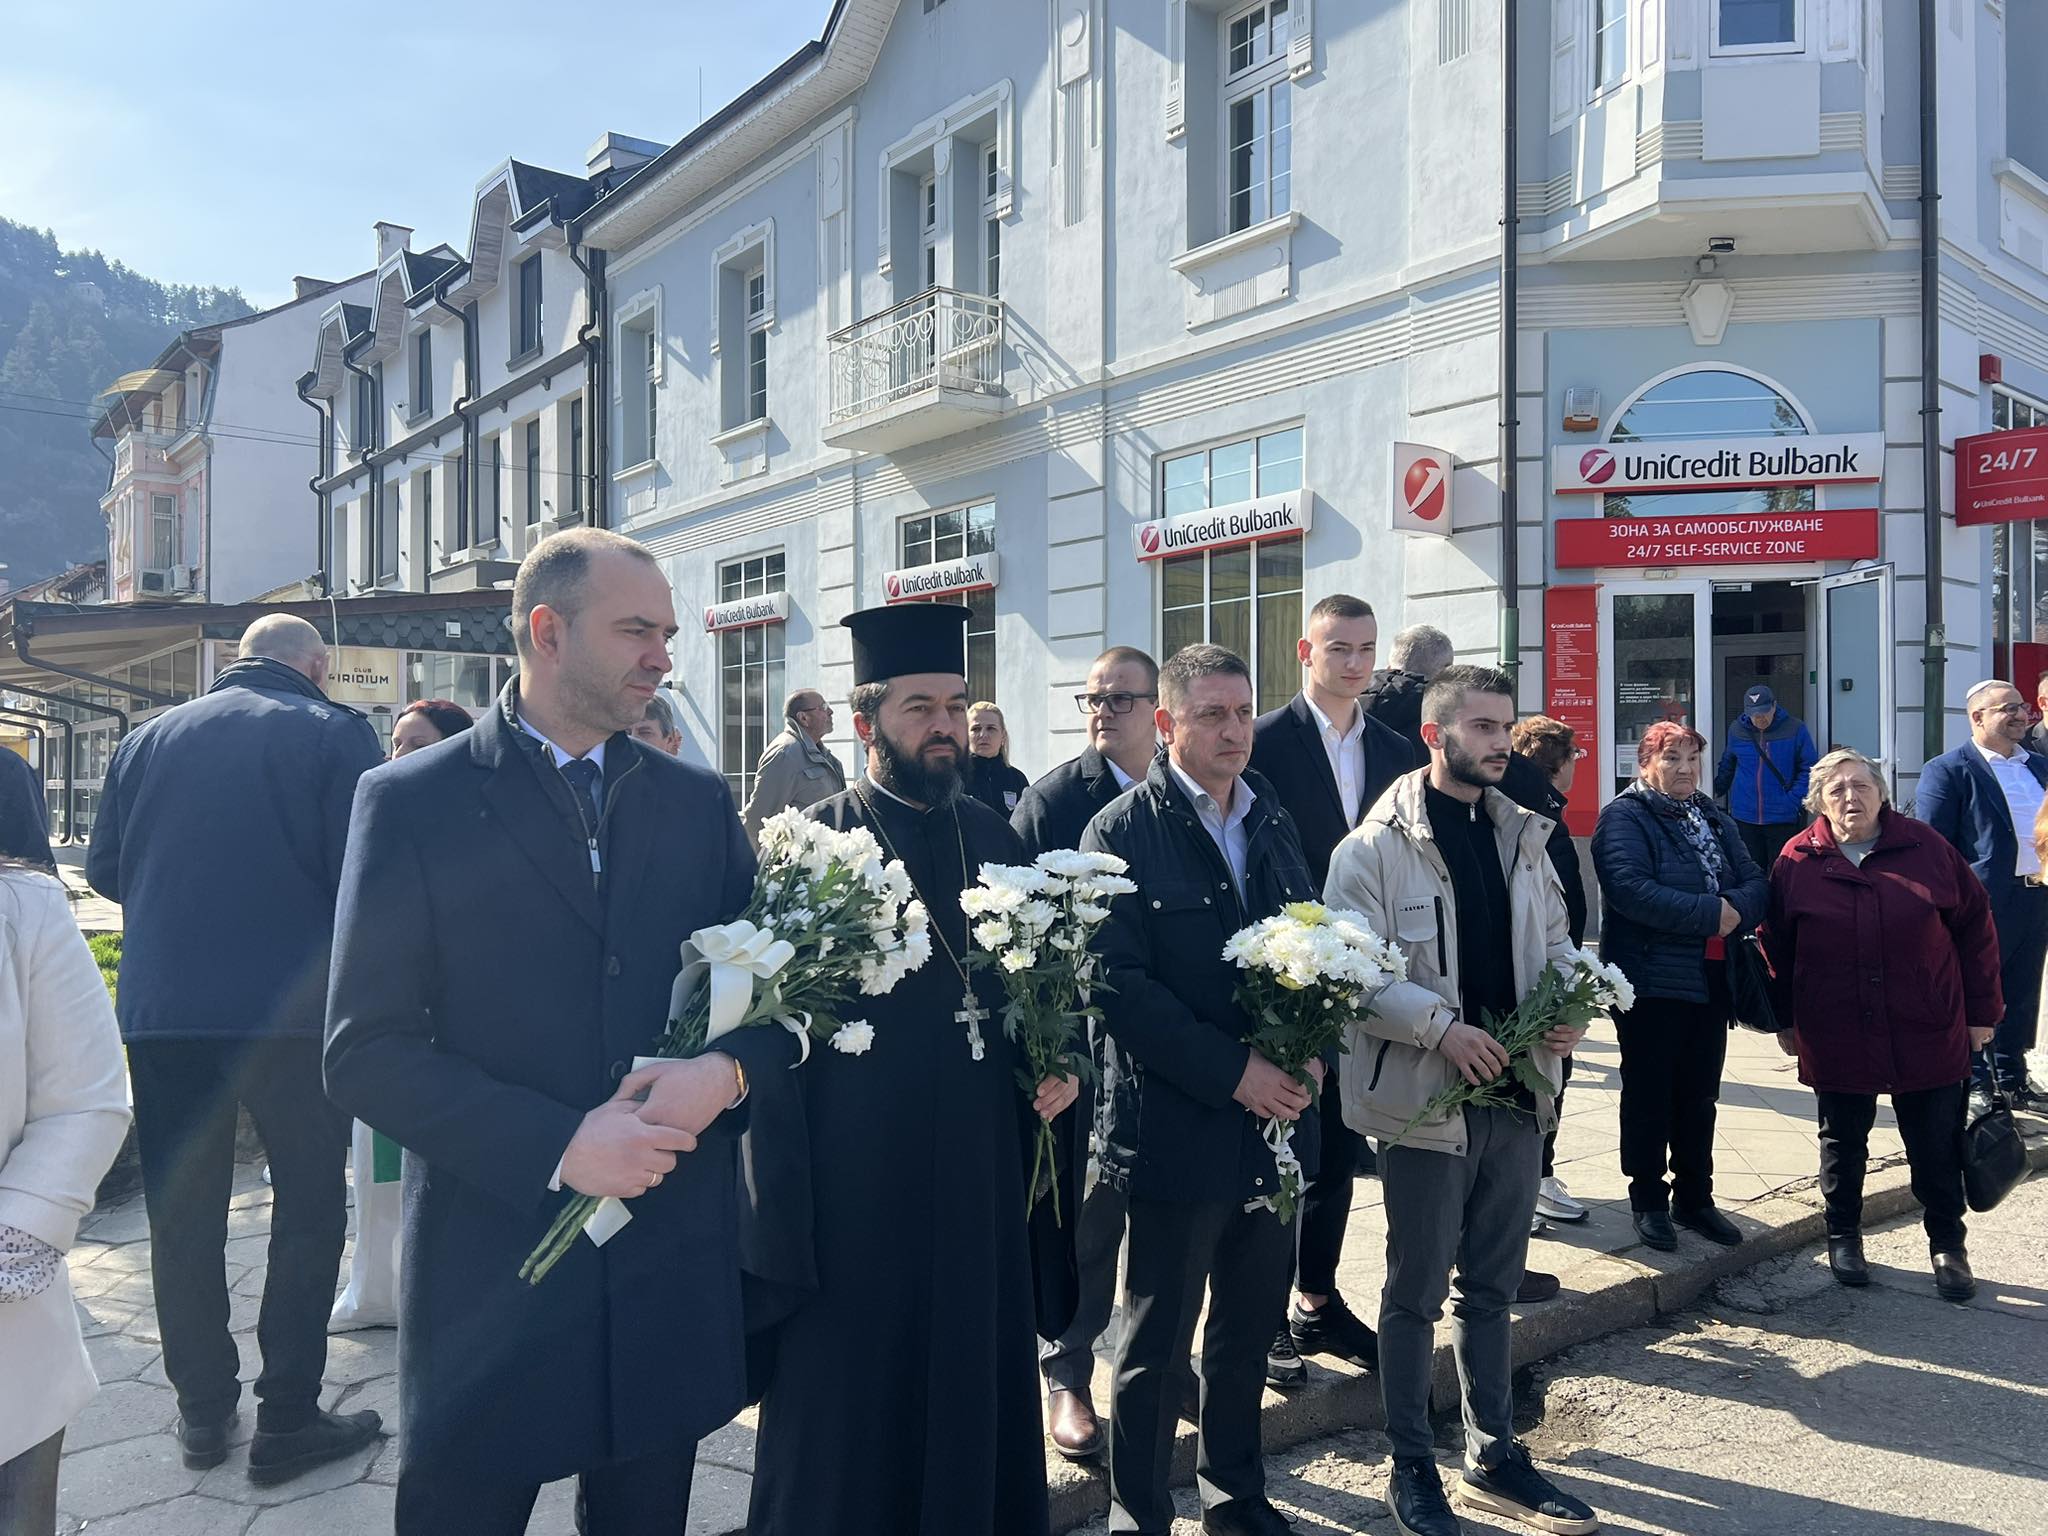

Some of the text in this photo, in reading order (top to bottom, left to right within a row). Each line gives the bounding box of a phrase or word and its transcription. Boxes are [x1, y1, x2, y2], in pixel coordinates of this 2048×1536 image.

[1625, 446, 1858, 480] UniCredit Bulbank
[1979, 448, 2038, 474] 24/7
[1981, 494, 2046, 508] UniCredit Bulbank
[1164, 503, 1293, 548] UniCredit Bulbank
[1609, 518, 1824, 538] ЗОНА ЗА САМООБСЛУЖВАНЕ
[1627, 540, 1805, 559] 24/7 SELF-SERVICE ZONE
[902, 562, 985, 593] UniCredit Bulbank
[716, 600, 775, 625] UniCredit Bulbank
[337, 673, 389, 684] IRIDIUM
